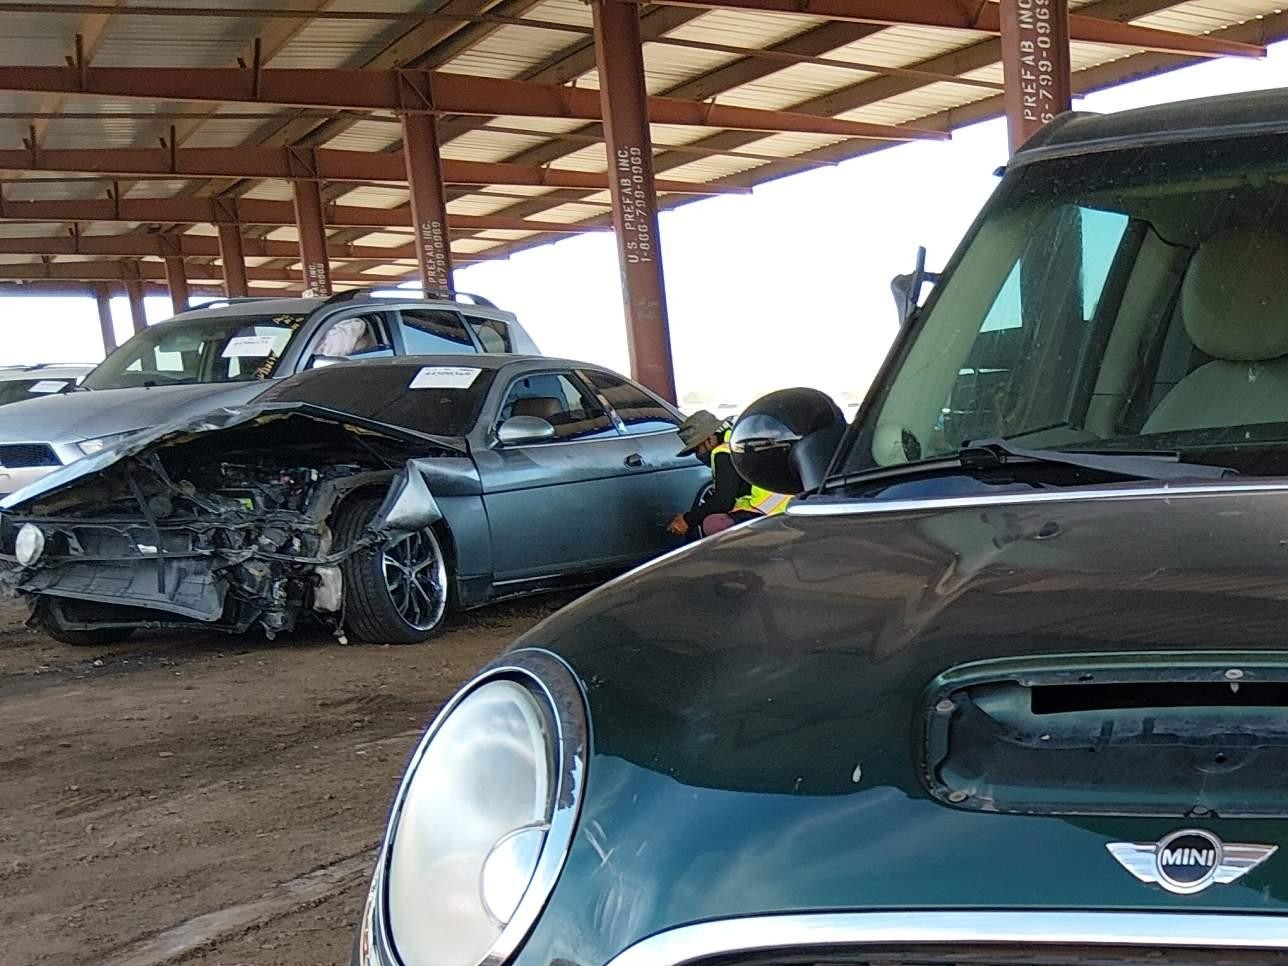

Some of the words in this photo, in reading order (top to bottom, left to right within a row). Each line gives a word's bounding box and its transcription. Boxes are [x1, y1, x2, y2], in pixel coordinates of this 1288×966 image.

[1020, 40, 1037, 120] PREFAB
[617, 145, 631, 171] INC.
[620, 178, 637, 231] PREFAB
[1162, 848, 1214, 866] MINI
